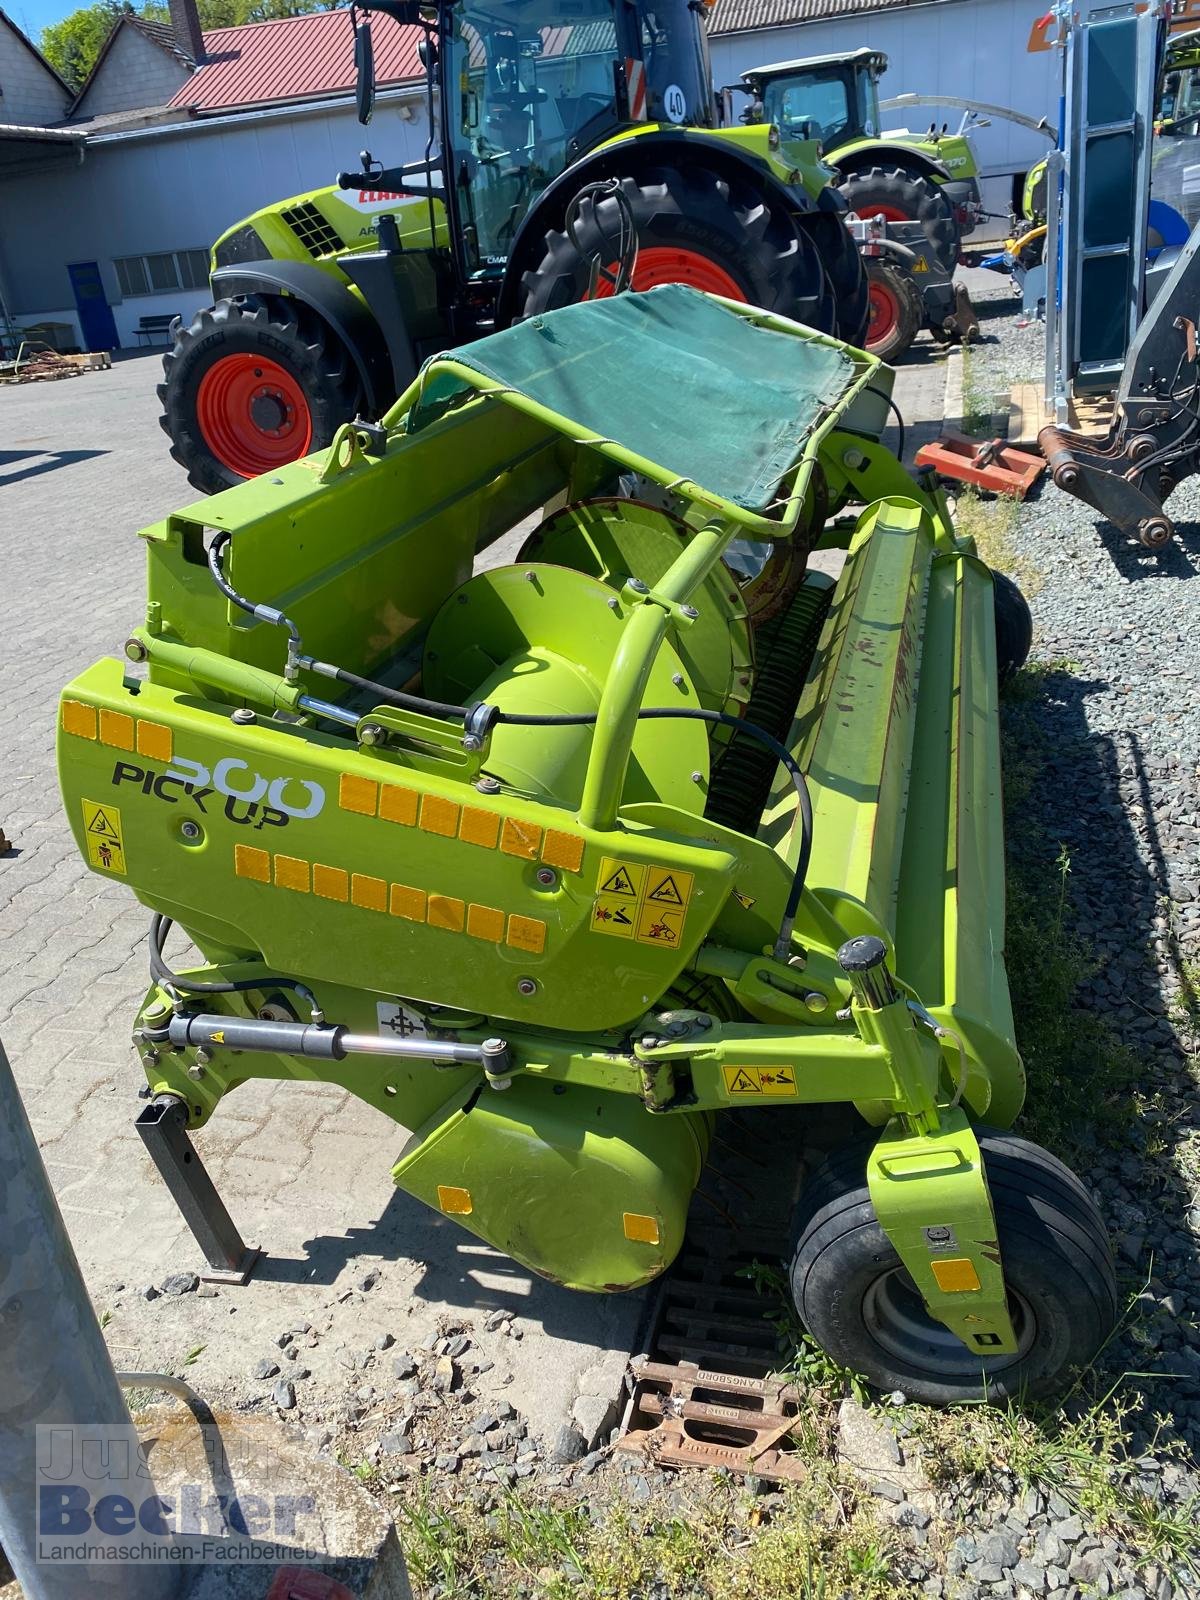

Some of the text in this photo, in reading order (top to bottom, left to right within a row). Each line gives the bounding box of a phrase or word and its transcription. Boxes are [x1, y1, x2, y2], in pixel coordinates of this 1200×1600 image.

[669, 92, 683, 116] 40
[111, 761, 290, 830] PICK UP
